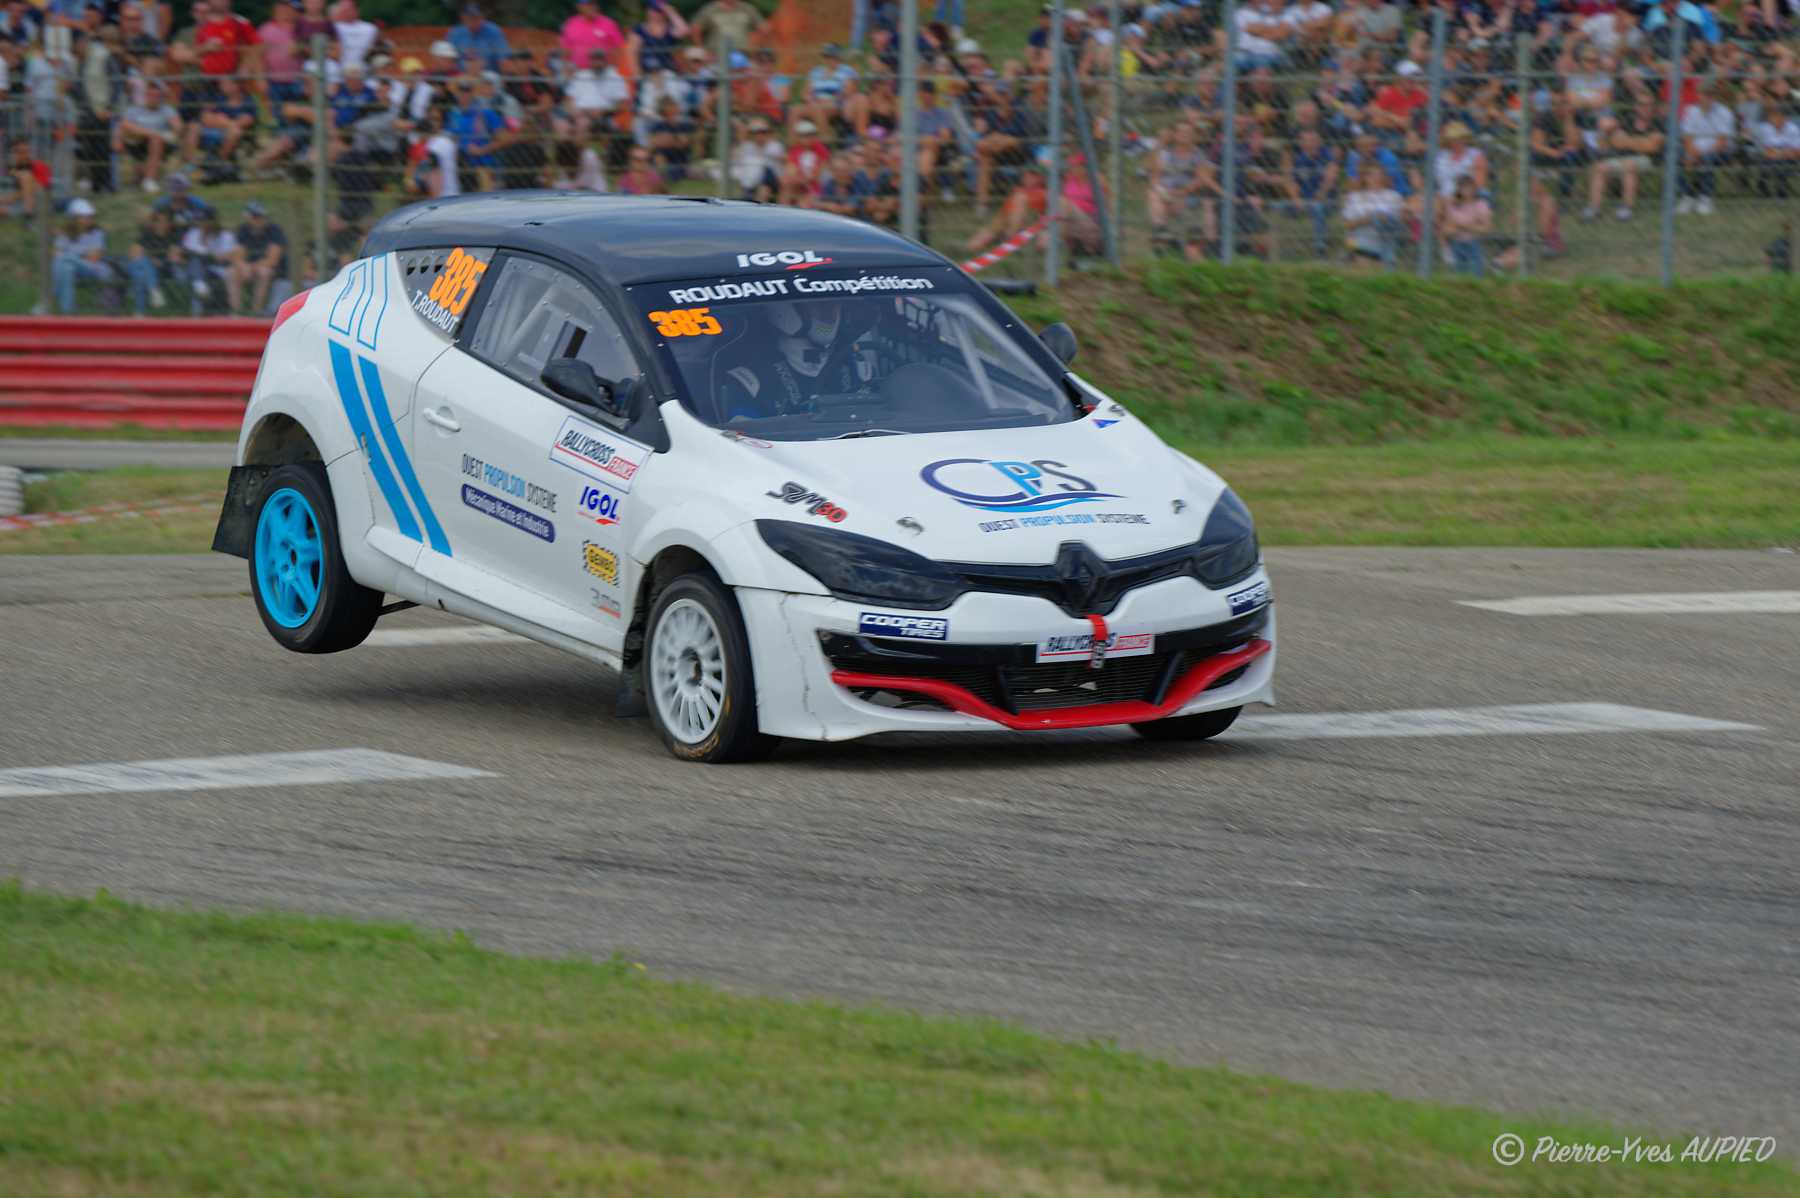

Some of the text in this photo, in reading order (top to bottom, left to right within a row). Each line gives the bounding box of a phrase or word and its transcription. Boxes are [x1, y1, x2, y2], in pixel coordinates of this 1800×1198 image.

[737, 250, 823, 268] IGOL
[429, 247, 488, 316] 385
[669, 274, 934, 304] ROUDAUT Compétition
[648, 307, 723, 338] 385
[560, 429, 616, 465] RALLYCROSS
[462, 453, 484, 481] OUEST
[580, 485, 619, 519] IGOL
[978, 518, 1020, 533] OUEST
[1019, 513, 1095, 529] PROPULSION
[861, 614, 946, 630] COOPER
[900, 627, 945, 638] TIRES
